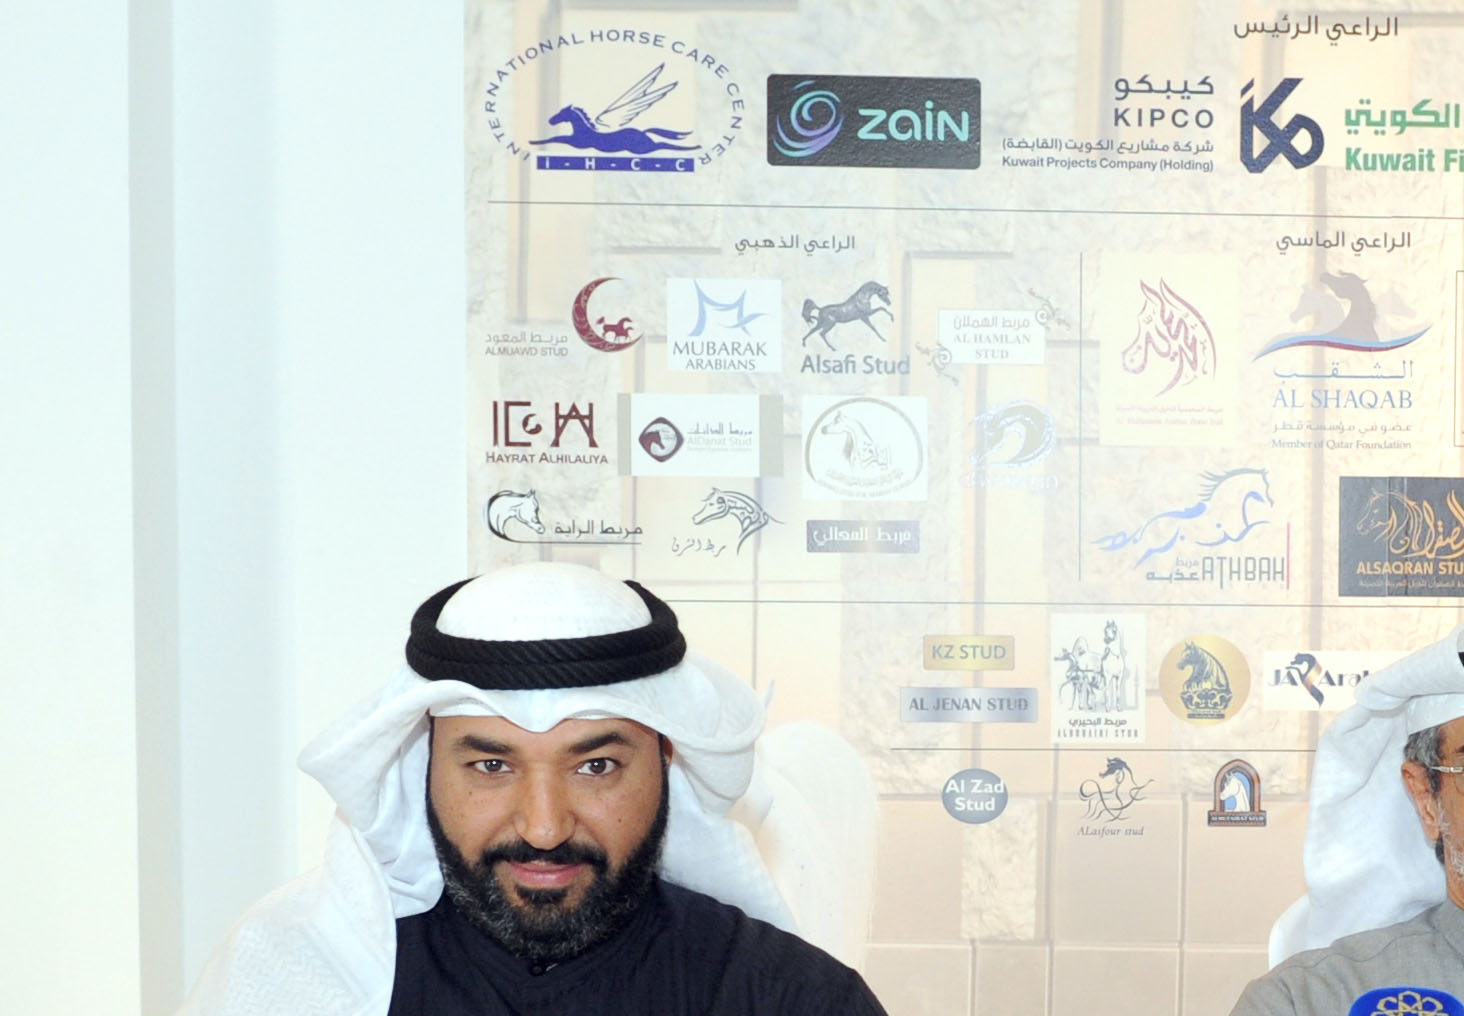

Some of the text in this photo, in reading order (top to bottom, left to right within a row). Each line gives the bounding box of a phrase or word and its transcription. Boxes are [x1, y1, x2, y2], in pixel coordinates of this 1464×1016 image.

[1234, 15, 1399, 46] الراعي الرئيس
[1114, 75, 1214, 100] كيبكو
[484, 29, 745, 165] INTERNATIONAL HORSE CARE CENTER
[857, 101, 969, 141] zain
[1114, 108, 1214, 128] KIPCO
[1345, 99, 1460, 136] الكويتي
[1002, 137, 1214, 155] شركة مشاريع الكويت (القابضة)
[1002, 156, 1214, 173] Kuwait Projects Company (Holding)
[1345, 148, 1435, 172] Kuwait
[734, 234, 856, 256] الراعي الذهبي
[1275, 230, 1411, 255] الراعي الماسي
[953, 333, 970, 344] AL
[541, 346, 569, 357] STUD
[672, 341, 768, 357] MUBARAK
[975, 348, 1009, 360] STUD
[685, 358, 756, 371] ARABIANS
[800, 353, 912, 376] Alsafi Stud
[1272, 388, 1413, 410] AL SHAQAB
[1273, 418, 1304, 434] قطر
[1306, 416, 1356, 435] مؤسسة
[1379, 417, 1413, 435] عضو
[1272, 438, 1312, 449] Member
[1326, 438, 1353, 450] Qatar
[1355, 438, 1412, 450] Foundation
[485, 451, 609, 465] HAYRAT ALHILALIYA
[600, 519, 643, 538] مربط
[877, 526, 912, 545] مربط
[1202, 556, 1285, 590] ATHBAH
[931, 644, 1007, 660] KZ STUD
[908, 697, 1029, 712] AL JENAN STUD
[945, 778, 1005, 794] Al Zad
[954, 796, 996, 811] Stud
